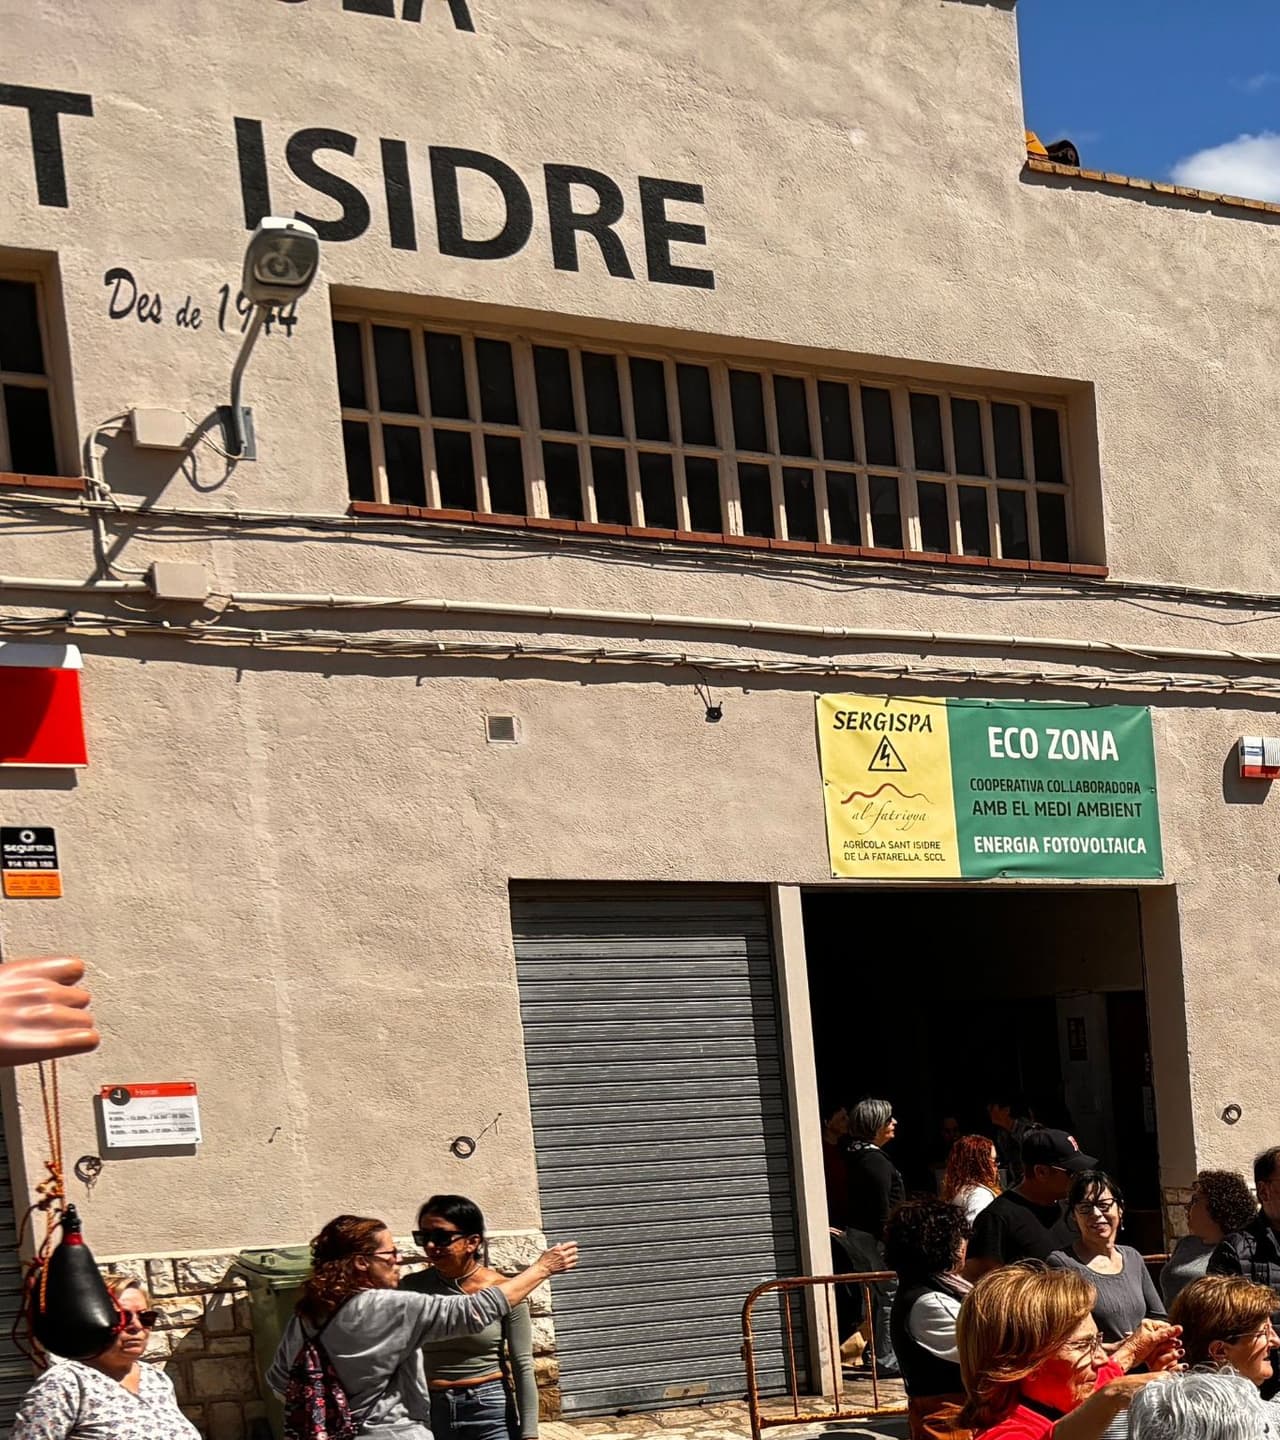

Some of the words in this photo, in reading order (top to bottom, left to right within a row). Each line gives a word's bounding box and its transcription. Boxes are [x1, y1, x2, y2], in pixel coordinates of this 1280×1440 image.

[234, 117, 714, 289] ISIDRE
[105, 268, 162, 324] Des
[176, 296, 202, 329] de
[833, 711, 932, 733] SERGISPA
[987, 726, 1039, 759] ECO
[1045, 728, 1119, 761] ZONA
[970, 778, 1044, 792] COOPERATIVA
[972, 800, 1007, 816] AMB
[1012, 801, 1030, 816] EL
[1034, 801, 1072, 817] MEDI
[1076, 802, 1142, 817] AMBIENT
[888, 840, 910, 849] SANT
[913, 841, 941, 850] ISIDRE
[974, 836, 1040, 853] ENERGIA
[1043, 837, 1147, 854] FOTOVOLTAICA
[844, 852, 856, 861] DE
[858, 852, 870, 861] LA
[925, 853, 946, 862] SCCL
